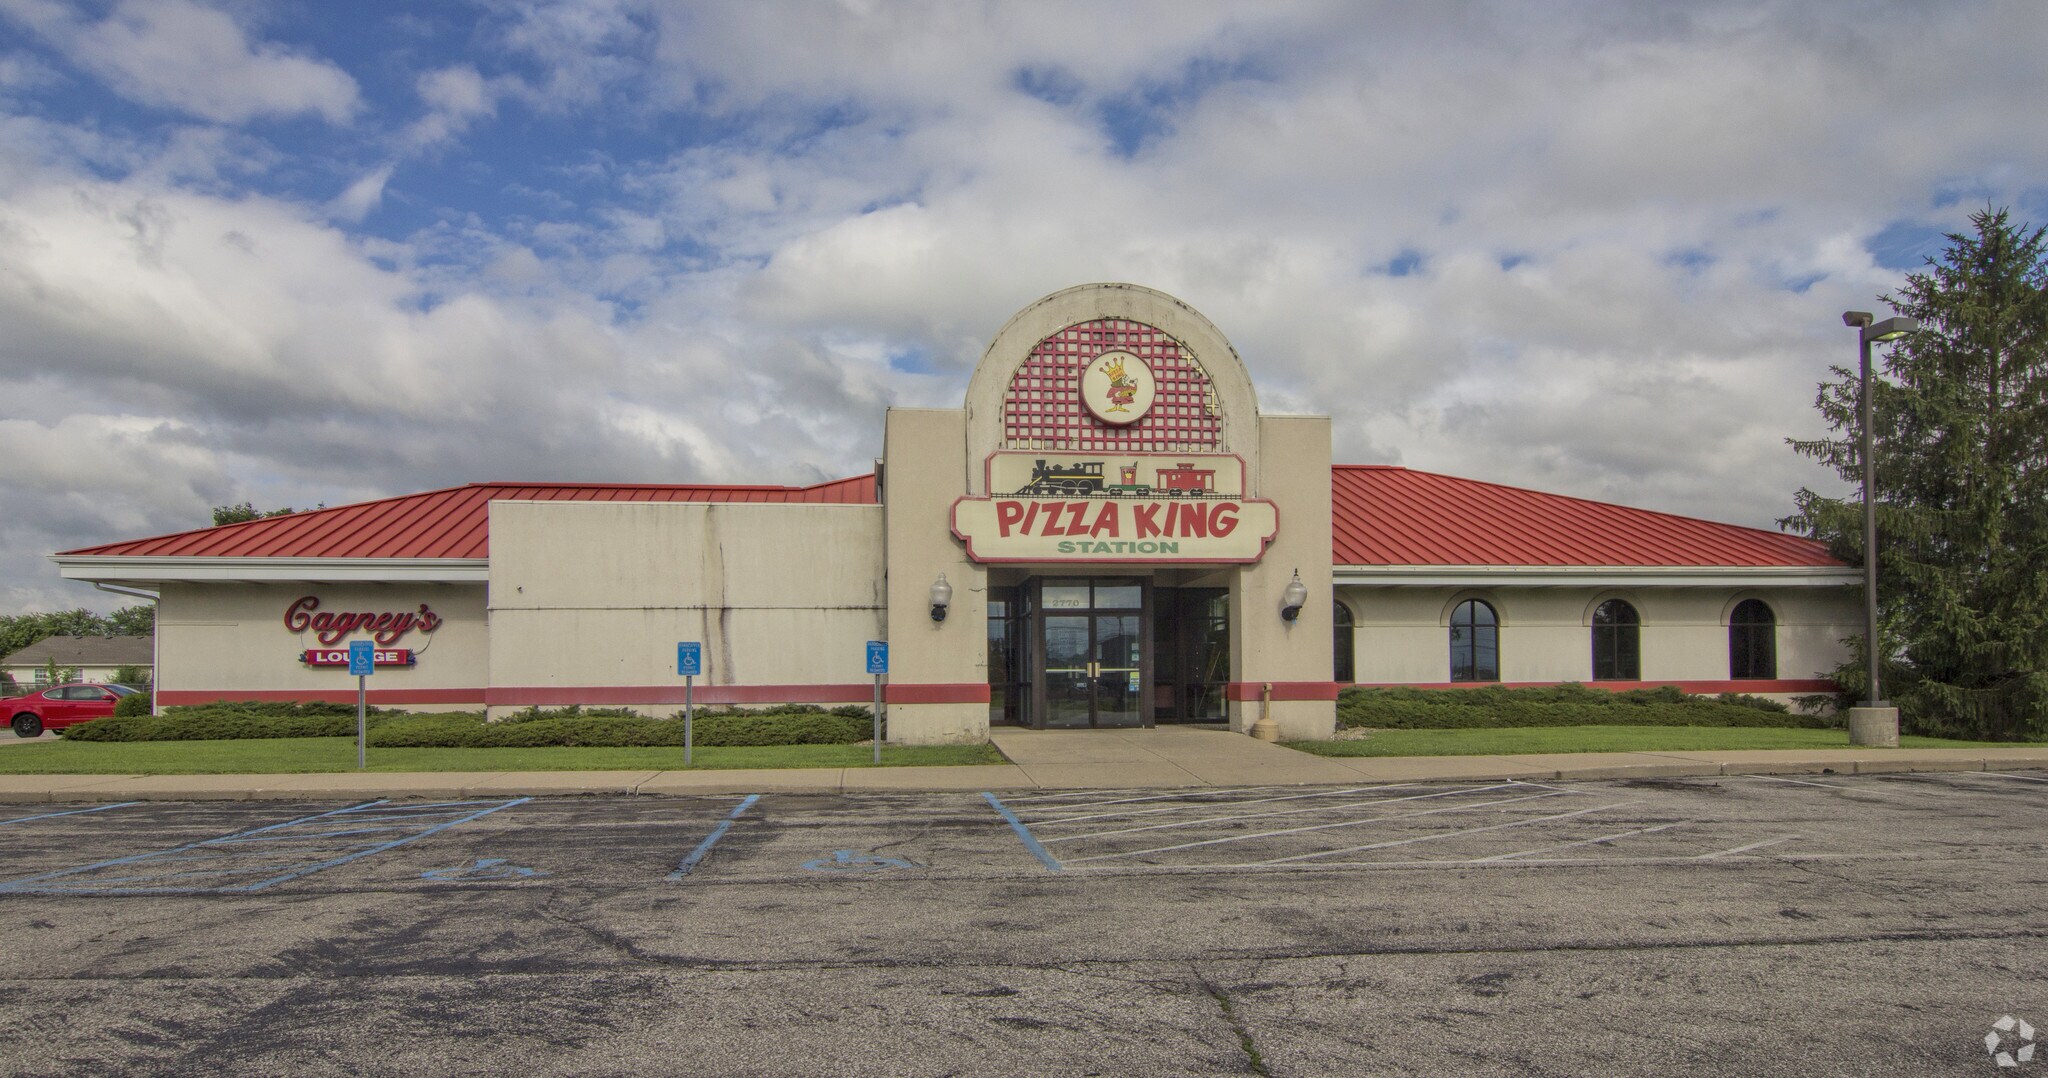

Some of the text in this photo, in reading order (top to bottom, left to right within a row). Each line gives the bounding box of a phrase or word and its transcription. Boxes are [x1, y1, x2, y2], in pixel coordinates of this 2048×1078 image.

[995, 501, 1241, 540] PIZZA KING
[1057, 541, 1179, 554] STATION
[1052, 599, 1080, 607] 2770
[284, 595, 443, 646] Cagney's
[316, 652, 398, 662] LOGE
